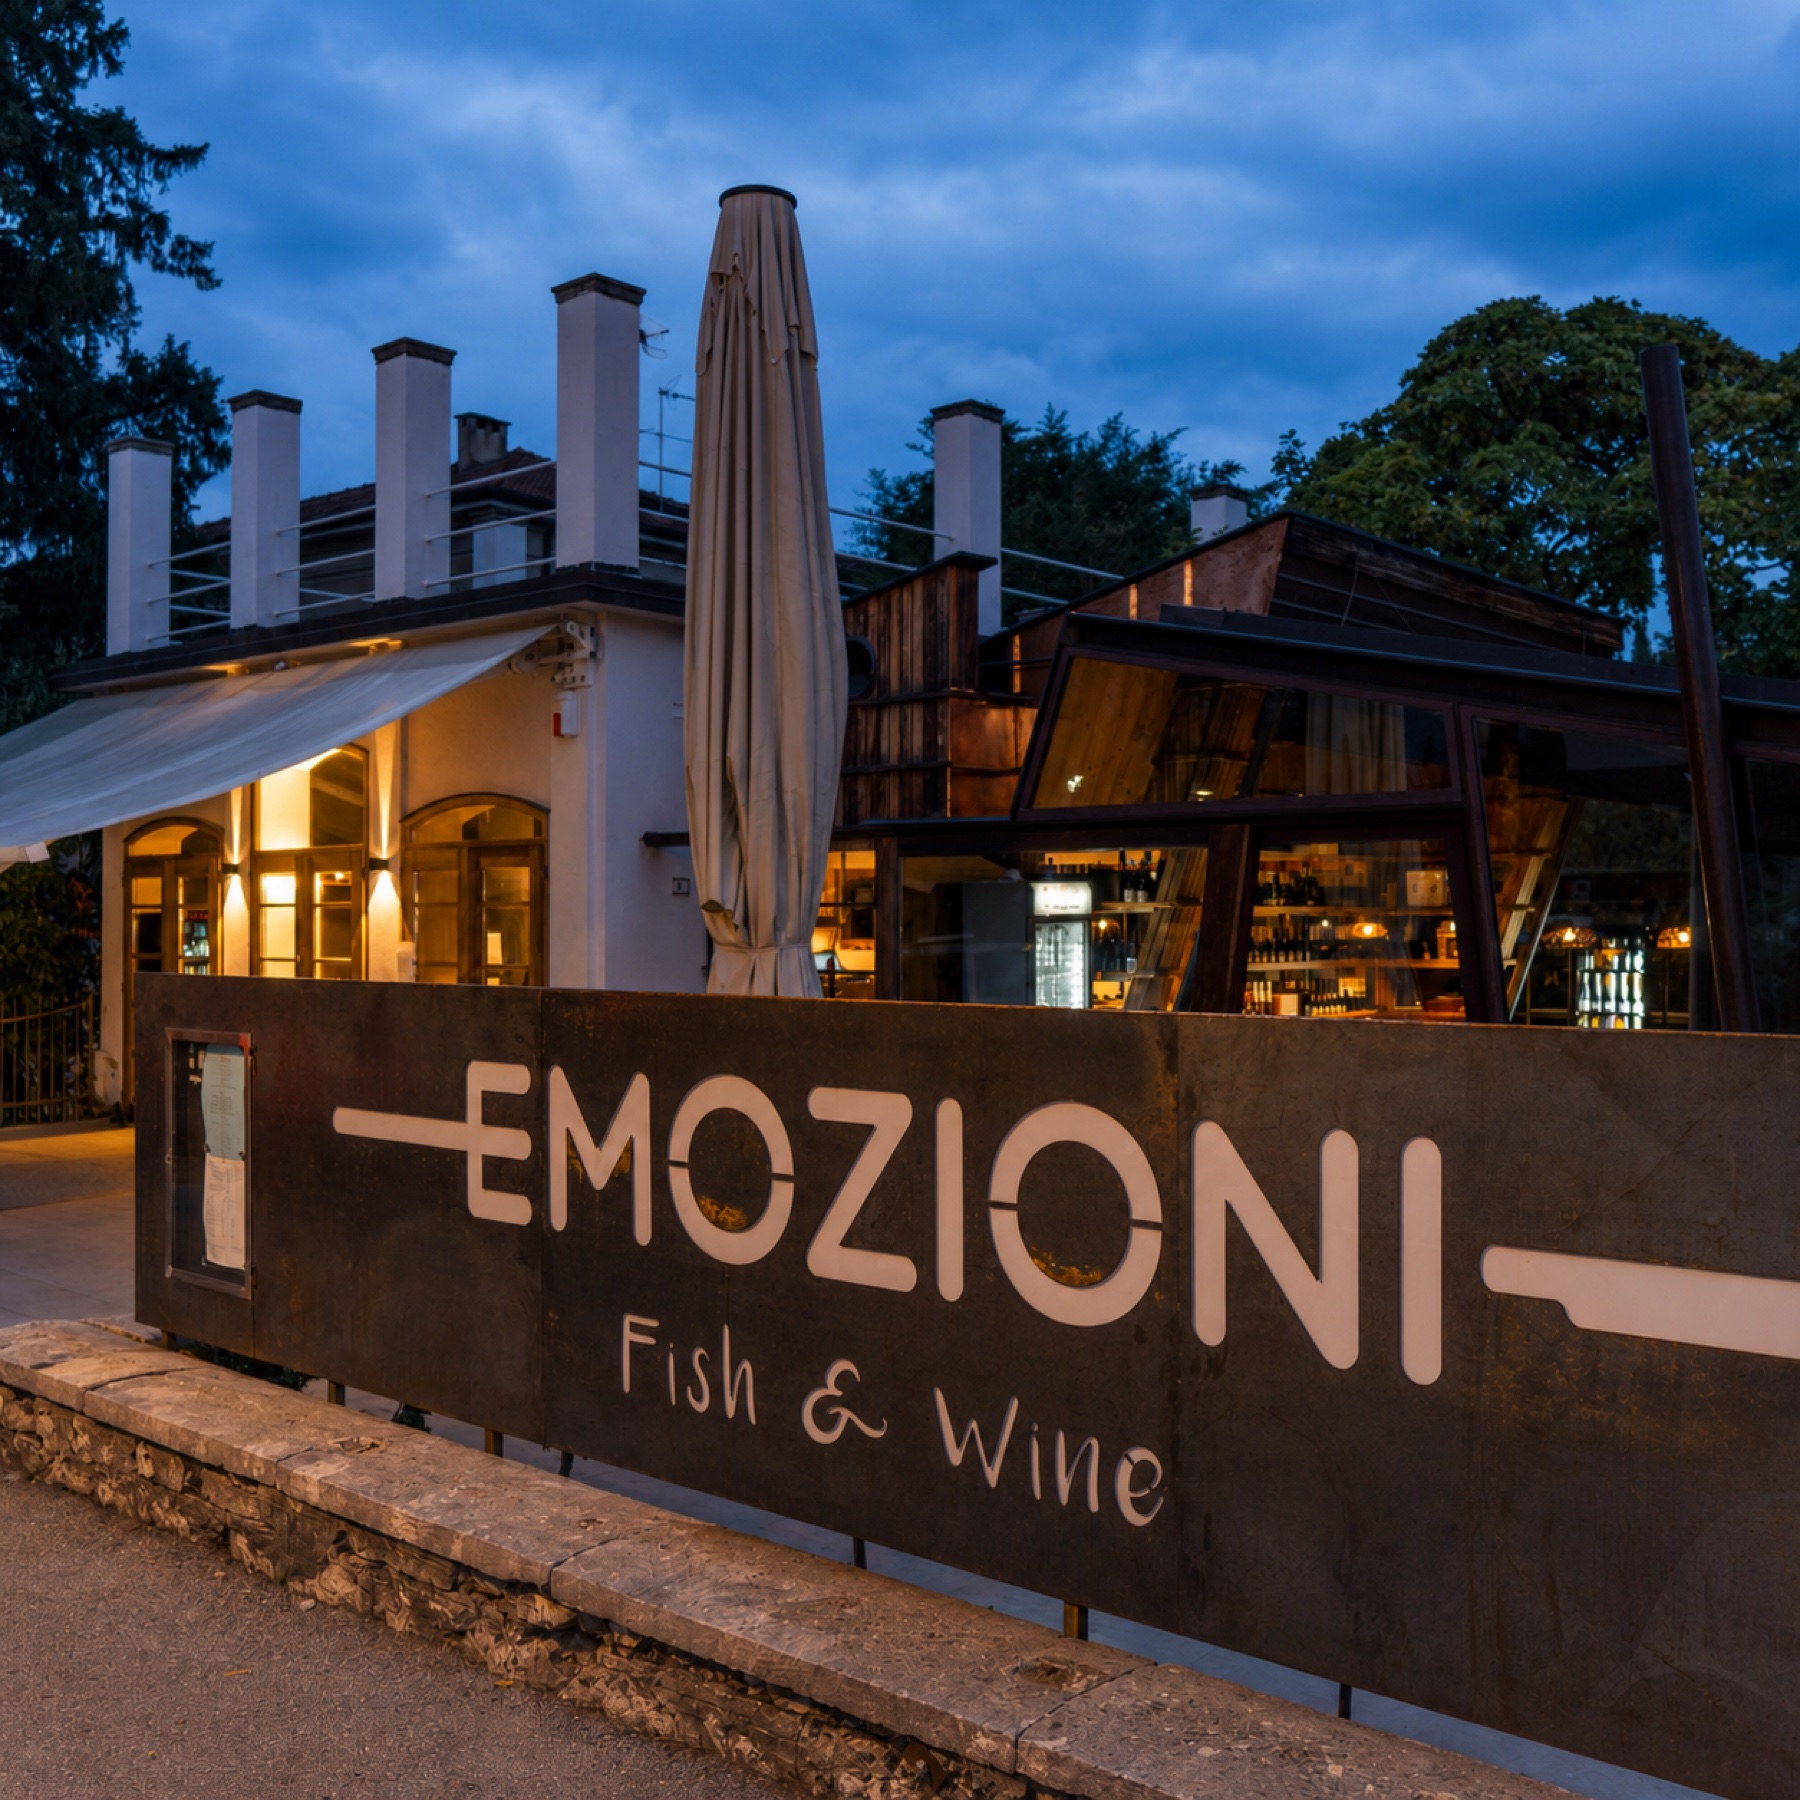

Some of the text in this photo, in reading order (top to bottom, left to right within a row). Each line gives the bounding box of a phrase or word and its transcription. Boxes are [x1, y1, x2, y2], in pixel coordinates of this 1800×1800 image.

[464, 1060, 1443, 1386] EMOZIONI
[620, 1313, 1165, 1527] Fish & Wine
